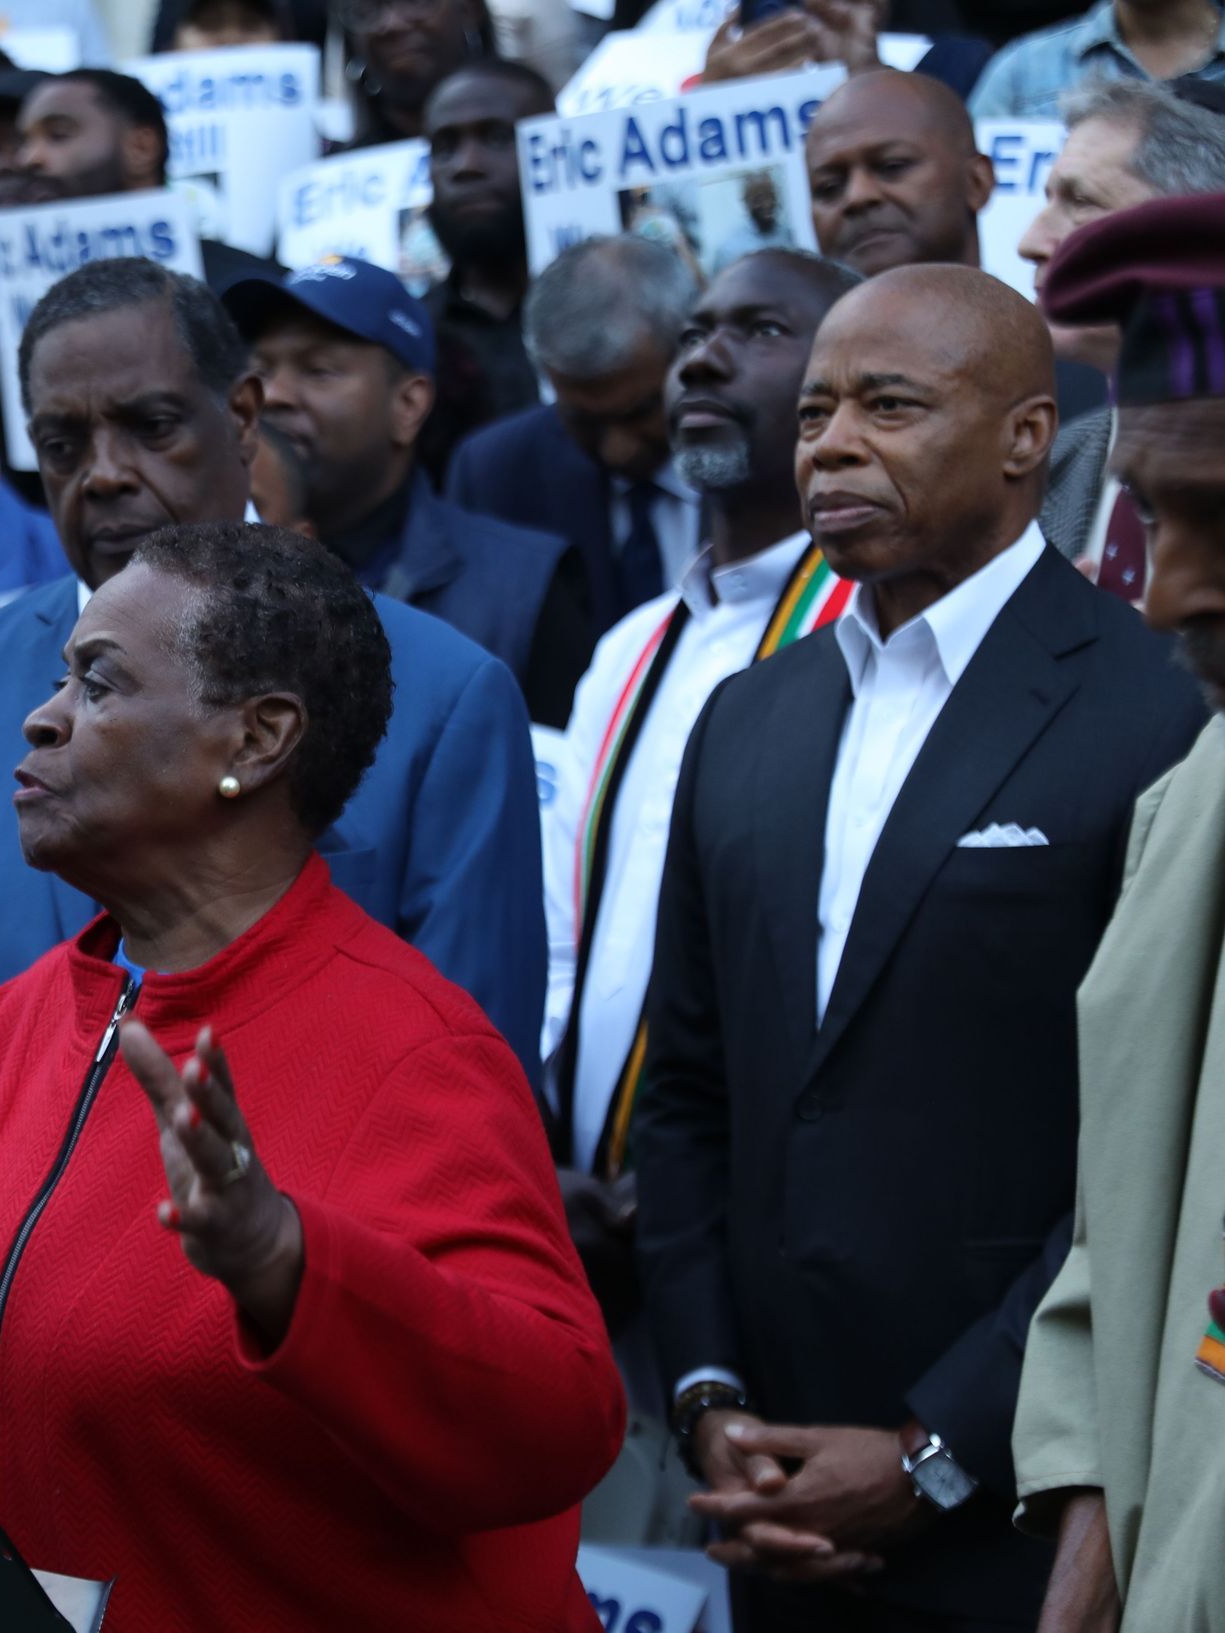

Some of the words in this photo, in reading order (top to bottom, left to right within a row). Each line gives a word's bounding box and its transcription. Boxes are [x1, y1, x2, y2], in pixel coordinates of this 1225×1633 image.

[159, 68, 300, 112] dams
[529, 128, 603, 193] Eric
[618, 98, 823, 177] Adams
[992, 135, 1055, 194] Er
[293, 168, 388, 227] Eric
[22, 220, 175, 272] Adams
